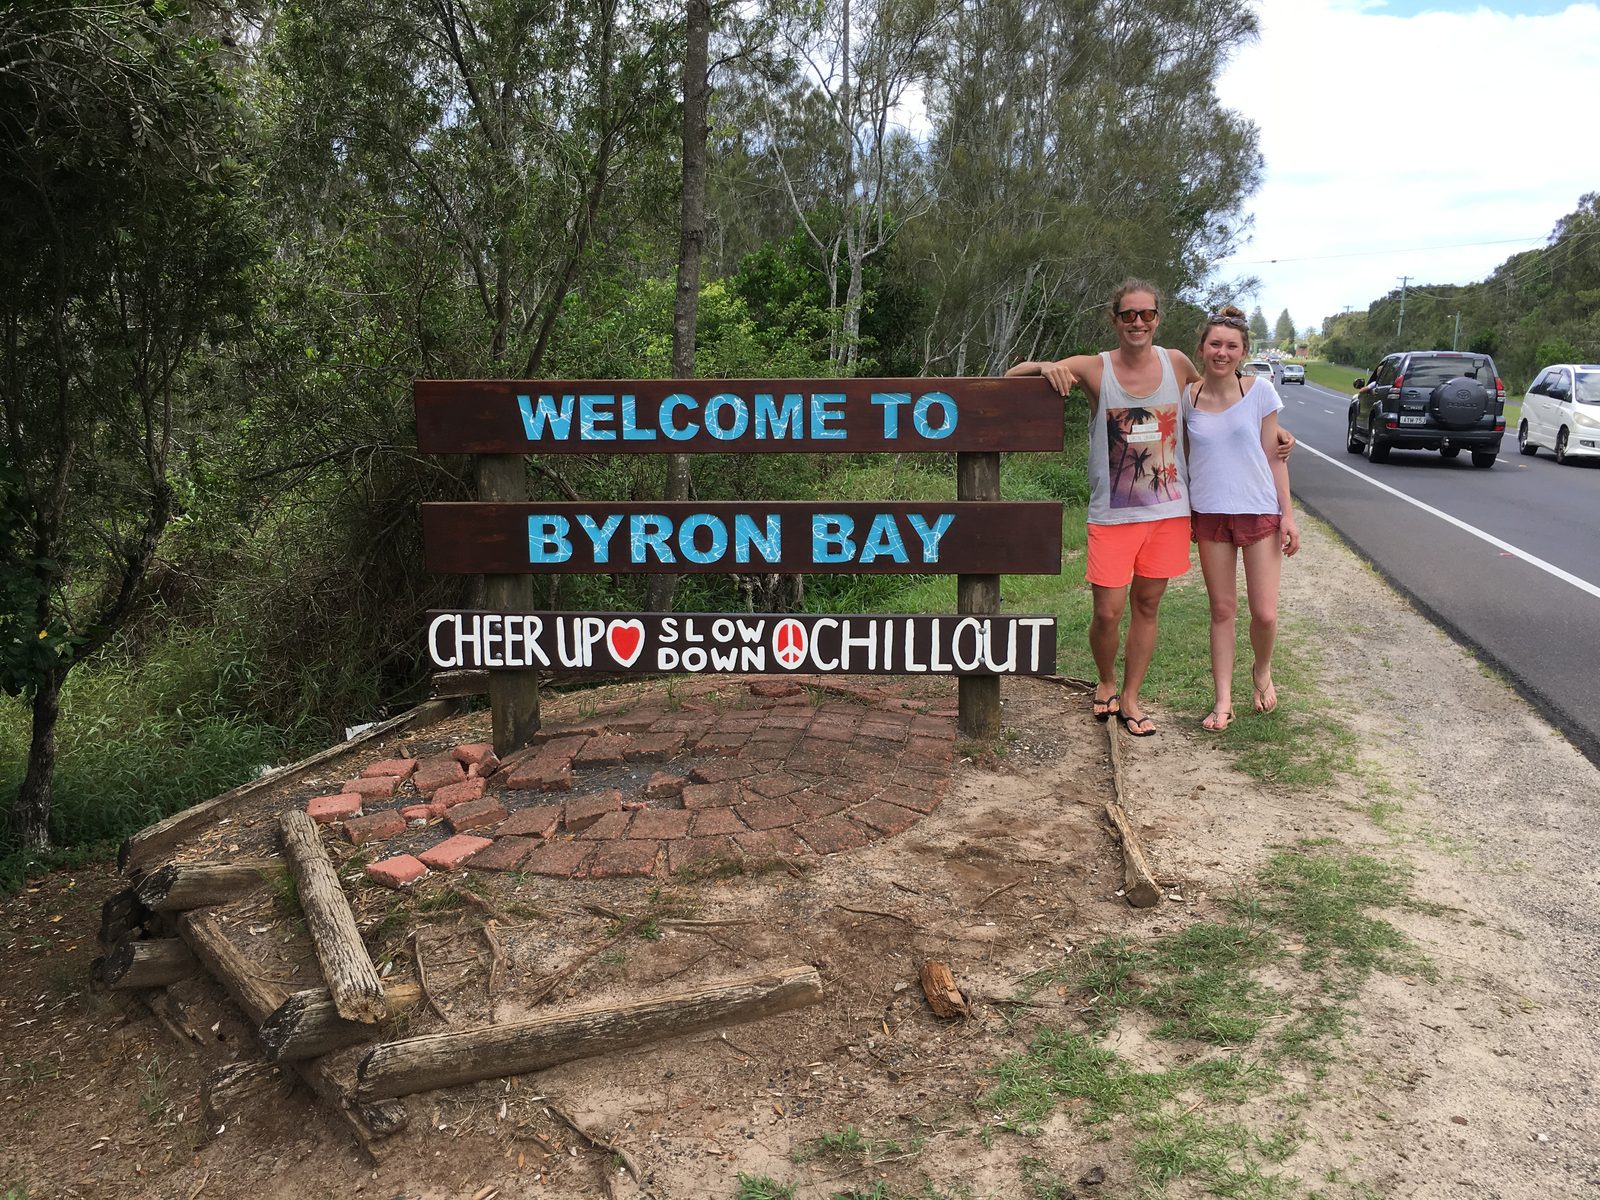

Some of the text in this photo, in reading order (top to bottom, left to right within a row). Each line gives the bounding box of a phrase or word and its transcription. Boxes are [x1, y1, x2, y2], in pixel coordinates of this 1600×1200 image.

[517, 392, 959, 441] WELCOME TO
[528, 514, 955, 564] BYRON BAY
[428, 614, 606, 668] CHEER UP
[658, 617, 766, 643] SLOW
[657, 646, 766, 672] DOWN
